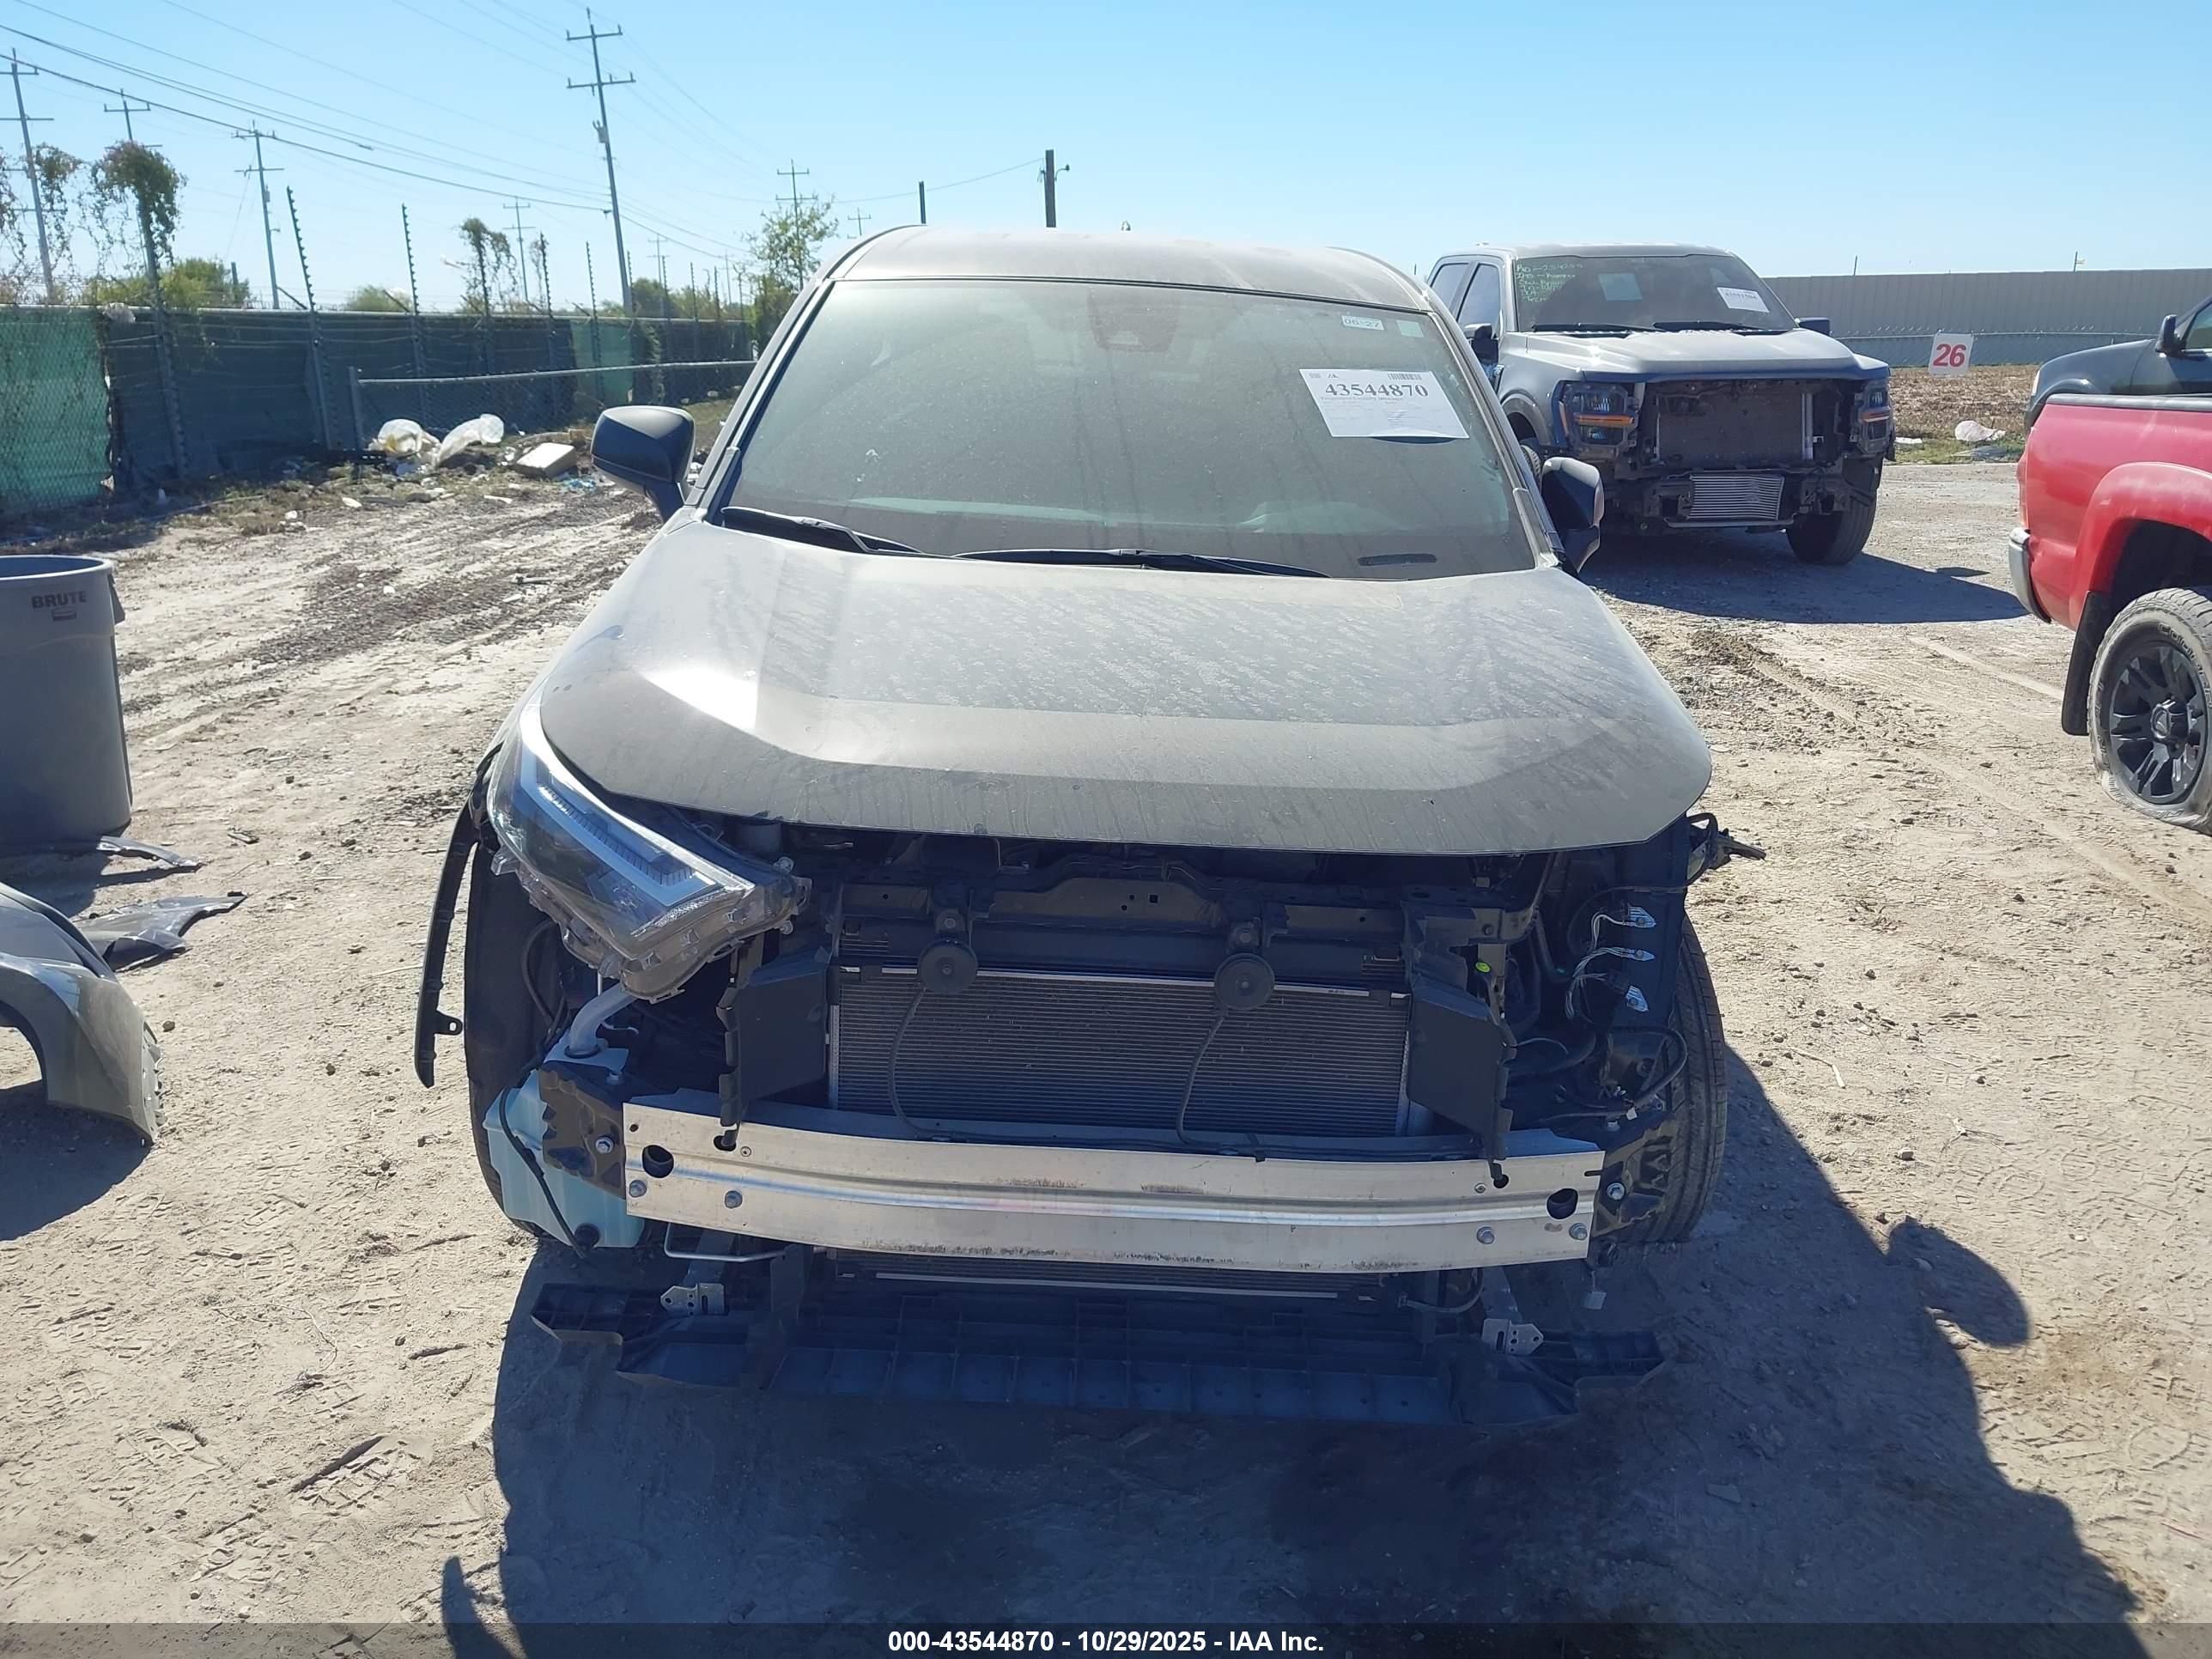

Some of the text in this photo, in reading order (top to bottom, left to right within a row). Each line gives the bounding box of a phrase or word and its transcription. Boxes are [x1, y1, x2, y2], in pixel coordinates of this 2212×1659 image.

[1933, 343, 1966, 367] 26
[1326, 384, 1429, 397] 43544870
[31, 591, 88, 609] BRUTE
